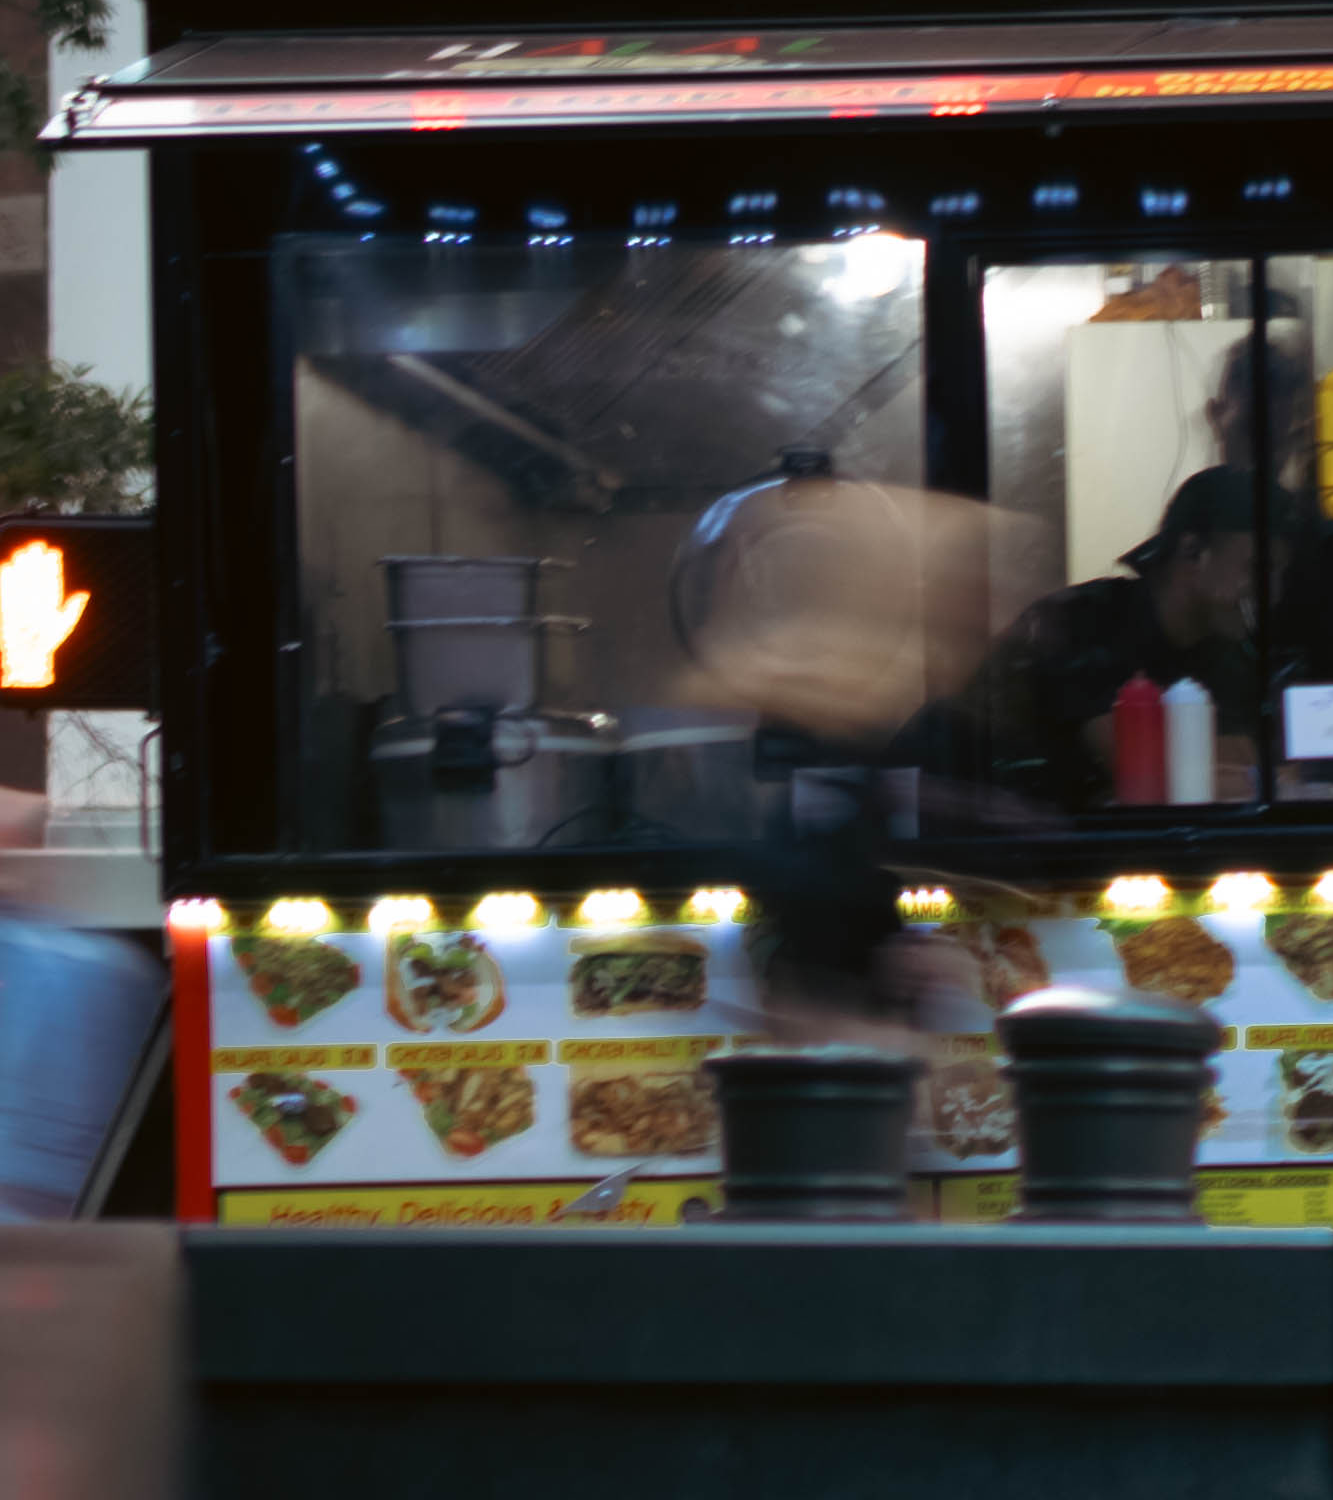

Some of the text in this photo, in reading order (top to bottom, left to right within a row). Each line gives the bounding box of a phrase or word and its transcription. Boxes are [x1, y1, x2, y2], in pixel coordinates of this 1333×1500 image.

[426, 36, 829, 62] HALAL
[396, 1199, 536, 1226] Delicious
[575, 1198, 658, 1228] asty
